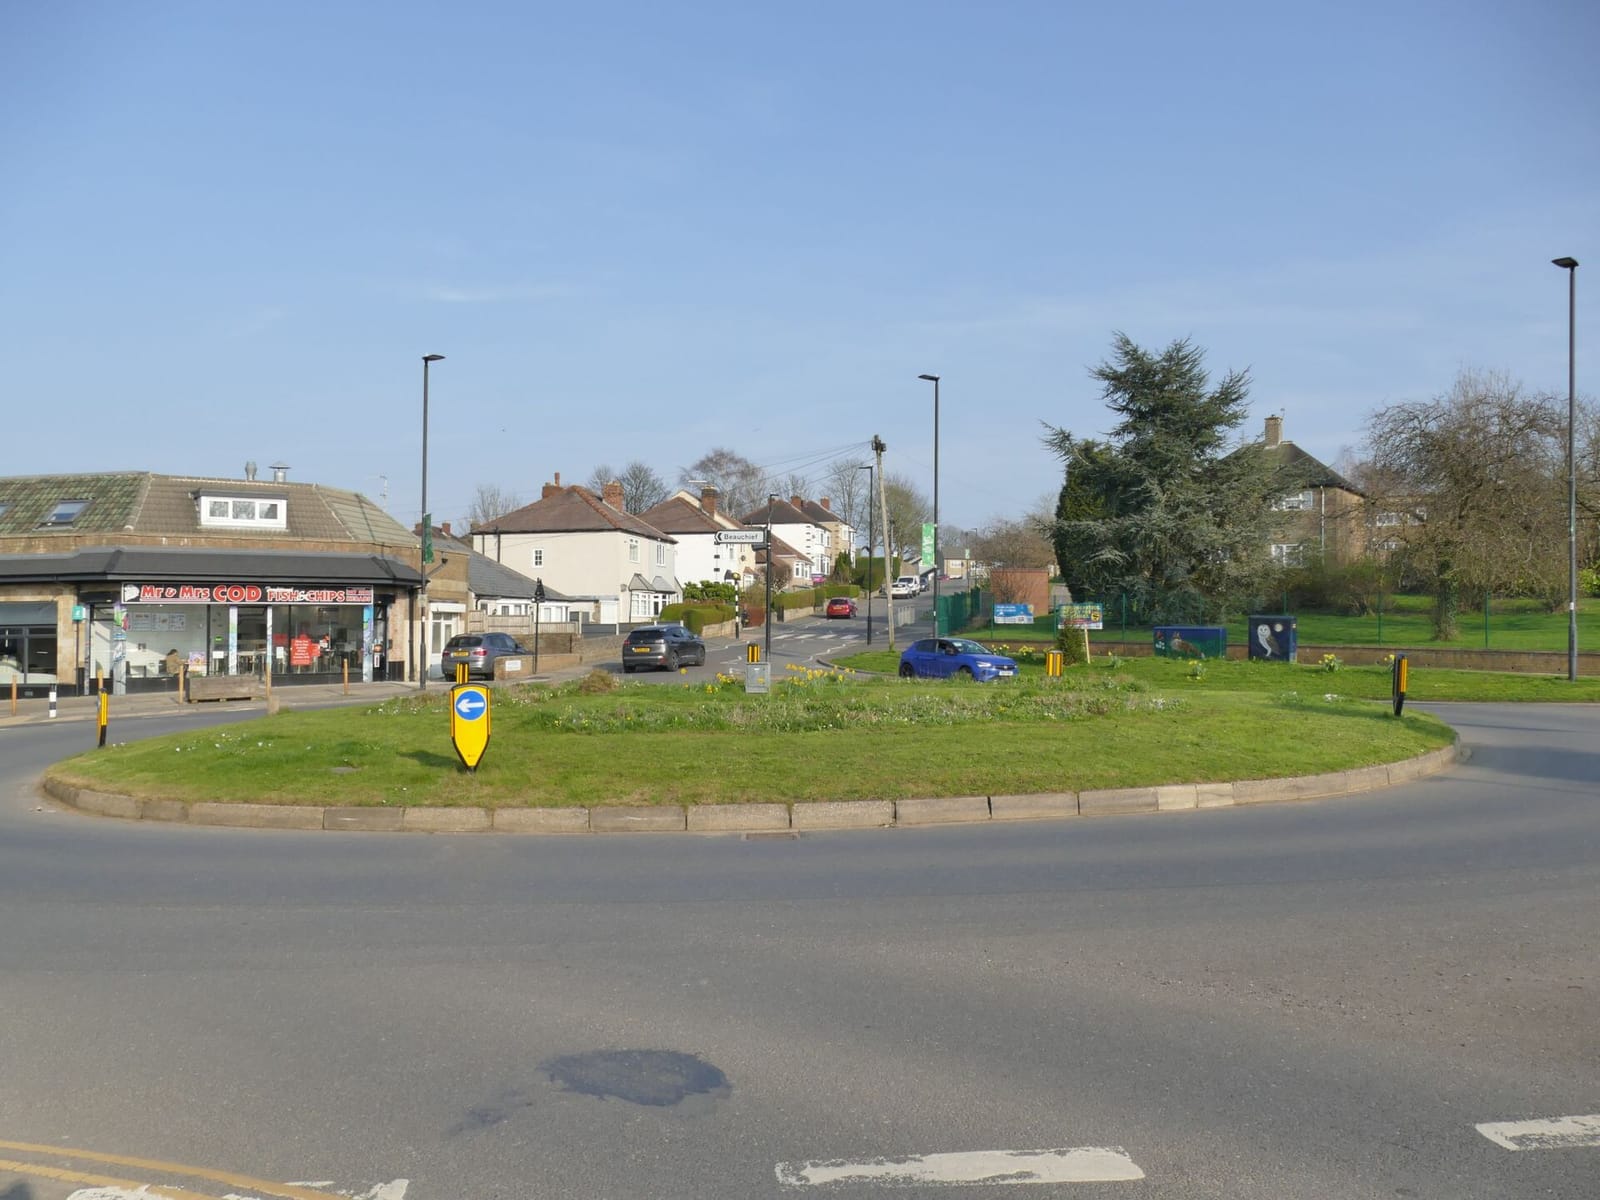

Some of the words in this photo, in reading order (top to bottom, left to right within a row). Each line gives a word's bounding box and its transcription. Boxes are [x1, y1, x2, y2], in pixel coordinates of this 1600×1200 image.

[140, 584, 164, 599] Mr
[165, 586, 177, 598] &
[179, 584, 210, 599] Mrs
[212, 584, 262, 602] COD
[267, 590, 298, 602] FISH
[307, 590, 346, 603] CHIPS
